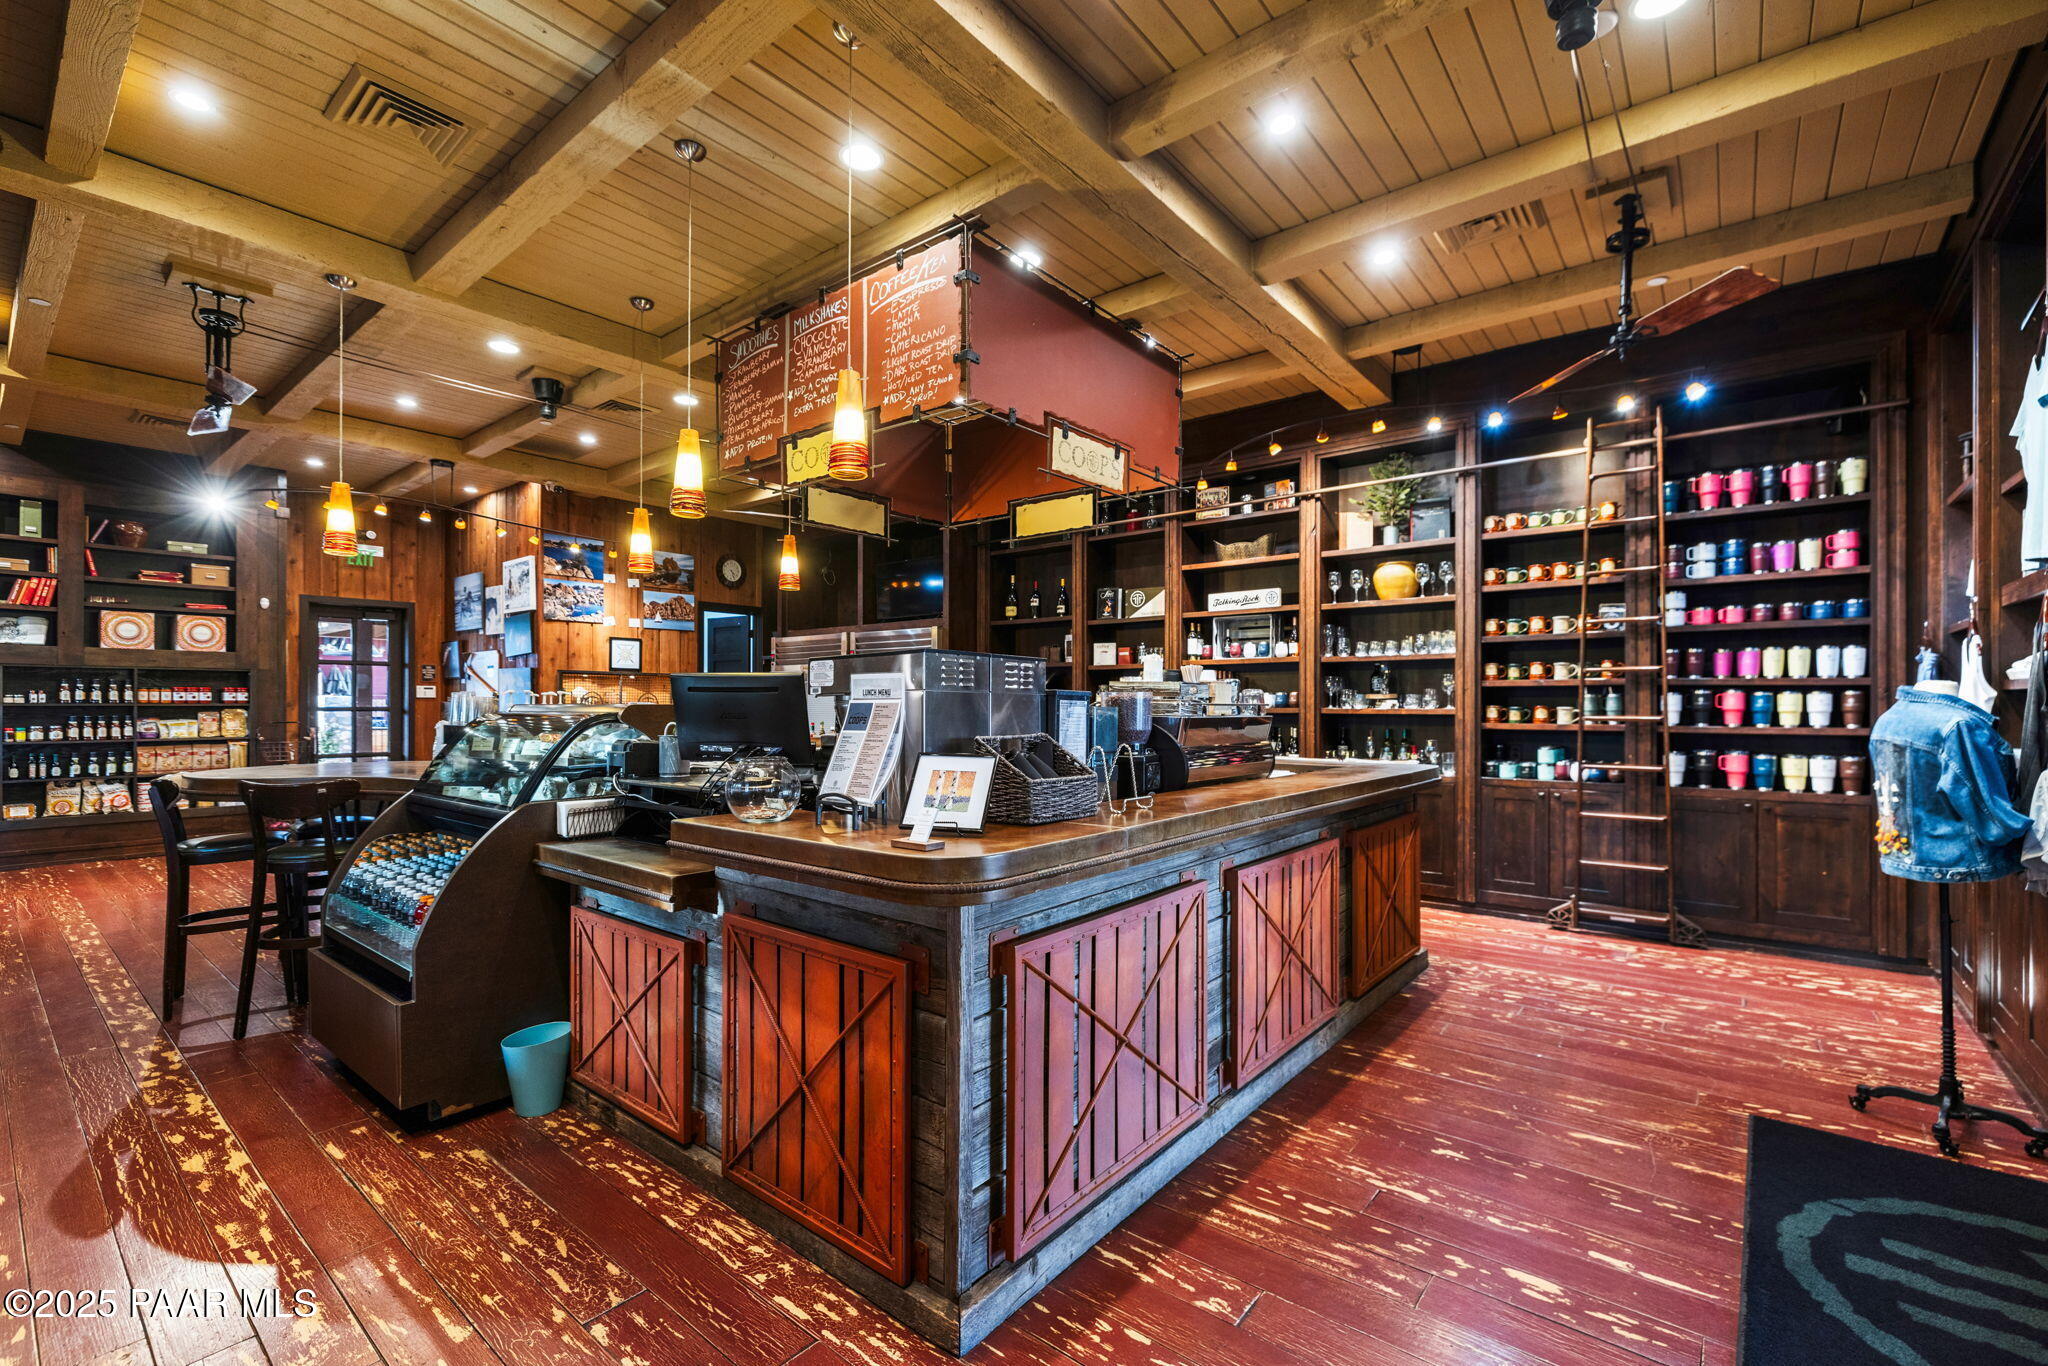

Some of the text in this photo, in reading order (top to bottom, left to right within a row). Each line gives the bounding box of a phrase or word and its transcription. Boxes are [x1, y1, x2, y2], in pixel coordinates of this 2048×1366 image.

[869, 254, 947, 306] COFFEE/TEA
[793, 297, 847, 336] MILKSHAKES
[892, 301, 920, 323] LATTE
[892, 311, 920, 331] MOCHA
[890, 327, 911, 343] CHAI
[891, 325, 945, 356] AMERICANO
[728, 324, 780, 369] SMOOTHIES
[802, 336, 837, 360] VANILLA
[886, 335, 956, 368] LIGHT ROAST DRIP
[908, 354, 933, 370] ROAST
[935, 345, 957, 360] DRIP
[728, 350, 770, 384] STRAWBERRY
[795, 341, 847, 375] STRAWBERRY
[799, 361, 835, 382] CARAMEL
[926, 364, 943, 375] TEA
[728, 384, 753, 403] MANGO
[803, 385, 829, 403] FOR AN
[808, 382, 813, 390] A
[910, 383, 924, 395] ANY
[928, 373, 953, 388] FLAVOR
[794, 403, 813, 417] EXTRA
[727, 409, 774, 435] MIXED BERRY
[746, 434, 773, 451] PROTEIN
[347, 552, 374, 567] EXIT
[863, 689, 891, 697] LUNCH MENU
